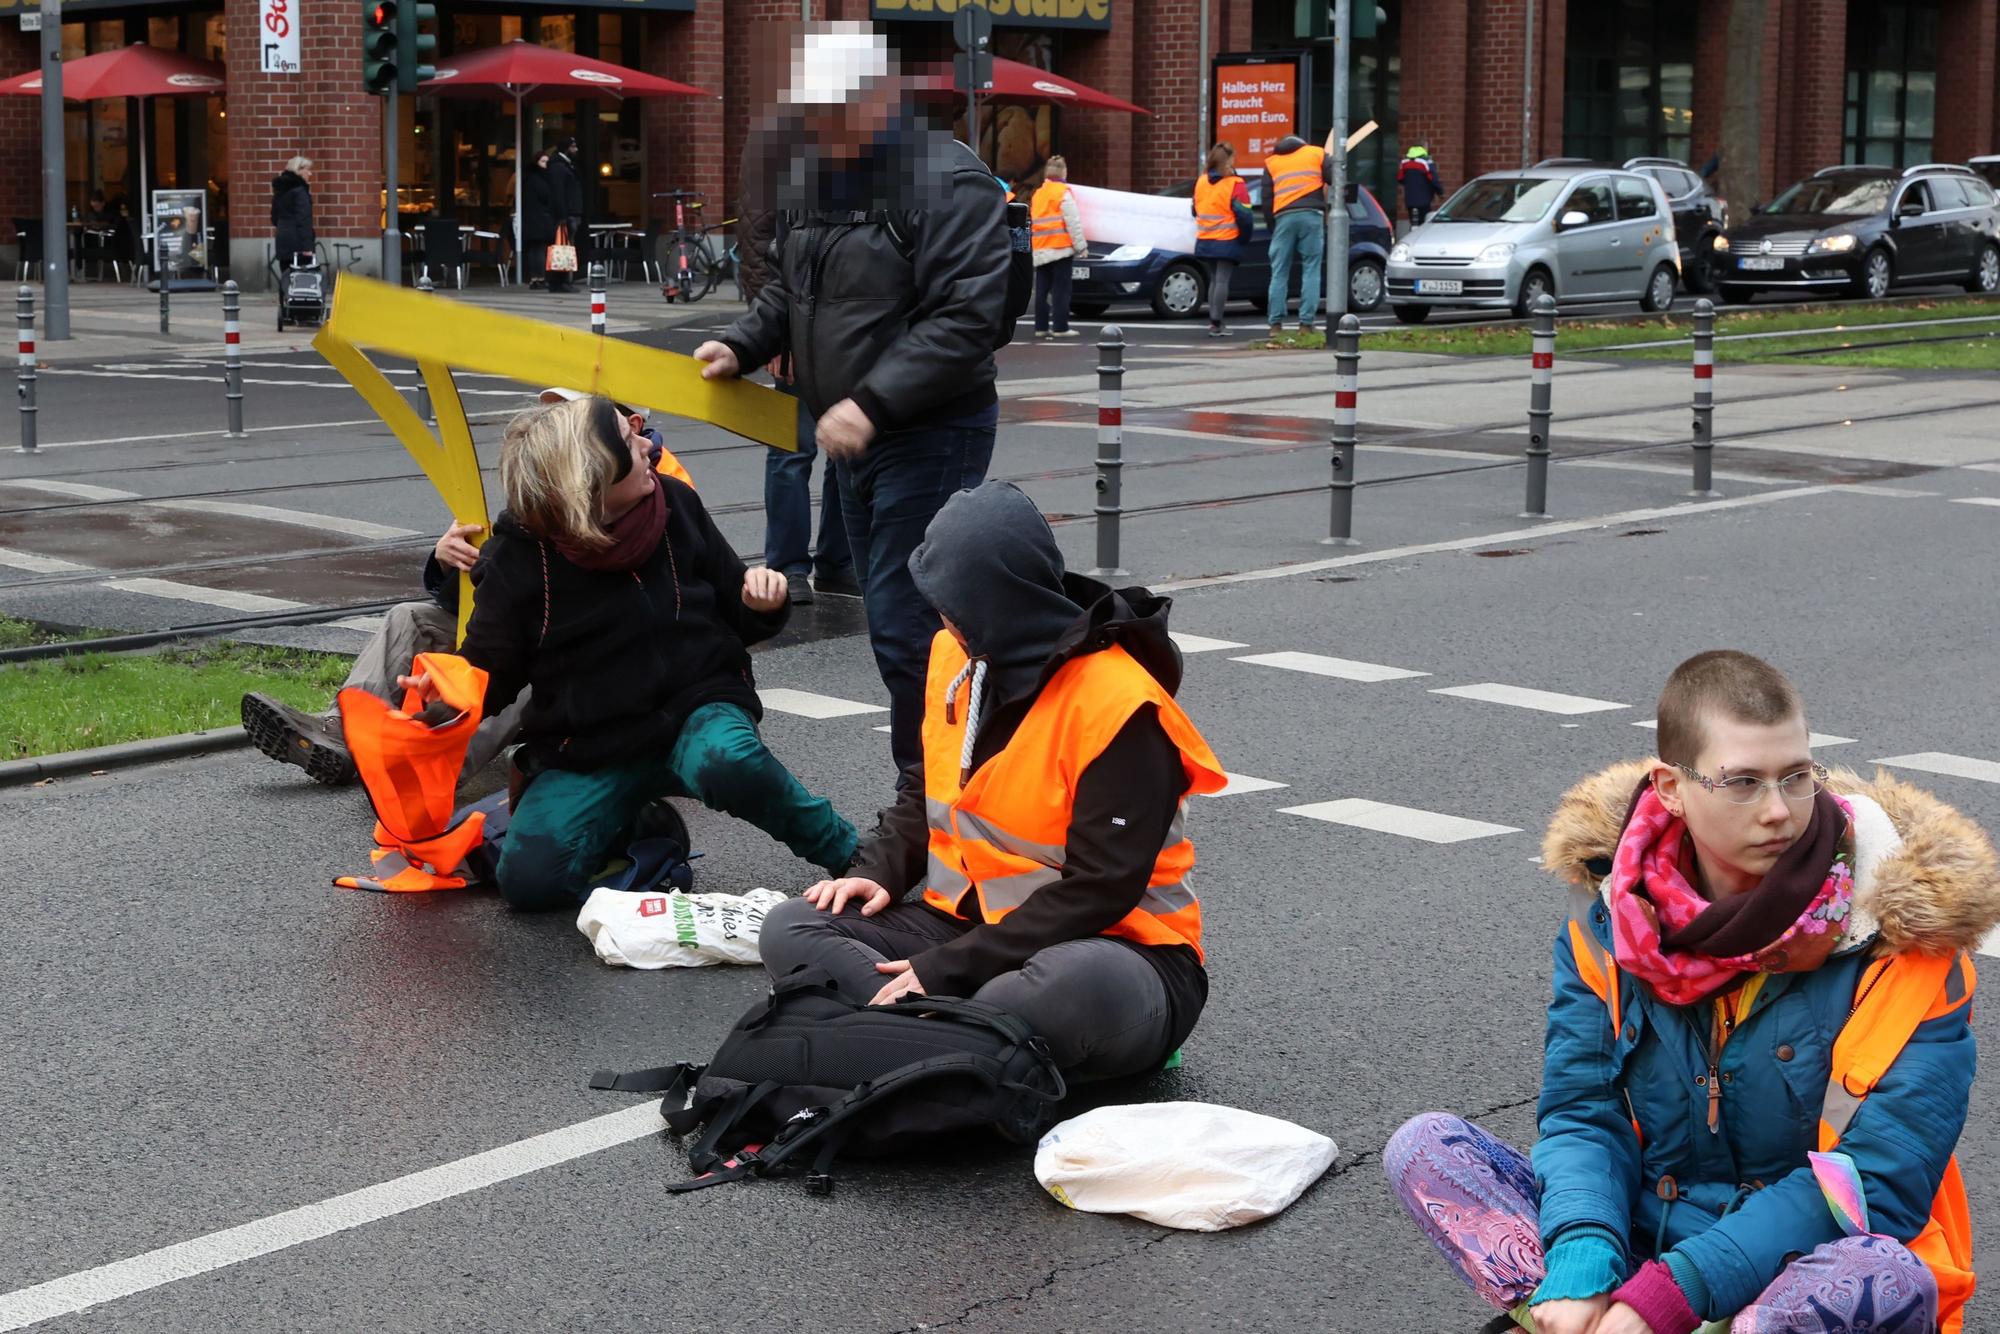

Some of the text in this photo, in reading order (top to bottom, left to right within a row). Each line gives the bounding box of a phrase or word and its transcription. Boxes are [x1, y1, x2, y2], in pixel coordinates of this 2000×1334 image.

[1222, 80, 1286, 93] Halbes Herz
[1221, 96, 1264, 109] braucht
[1221, 111, 1289, 127] ganzen Euro.
